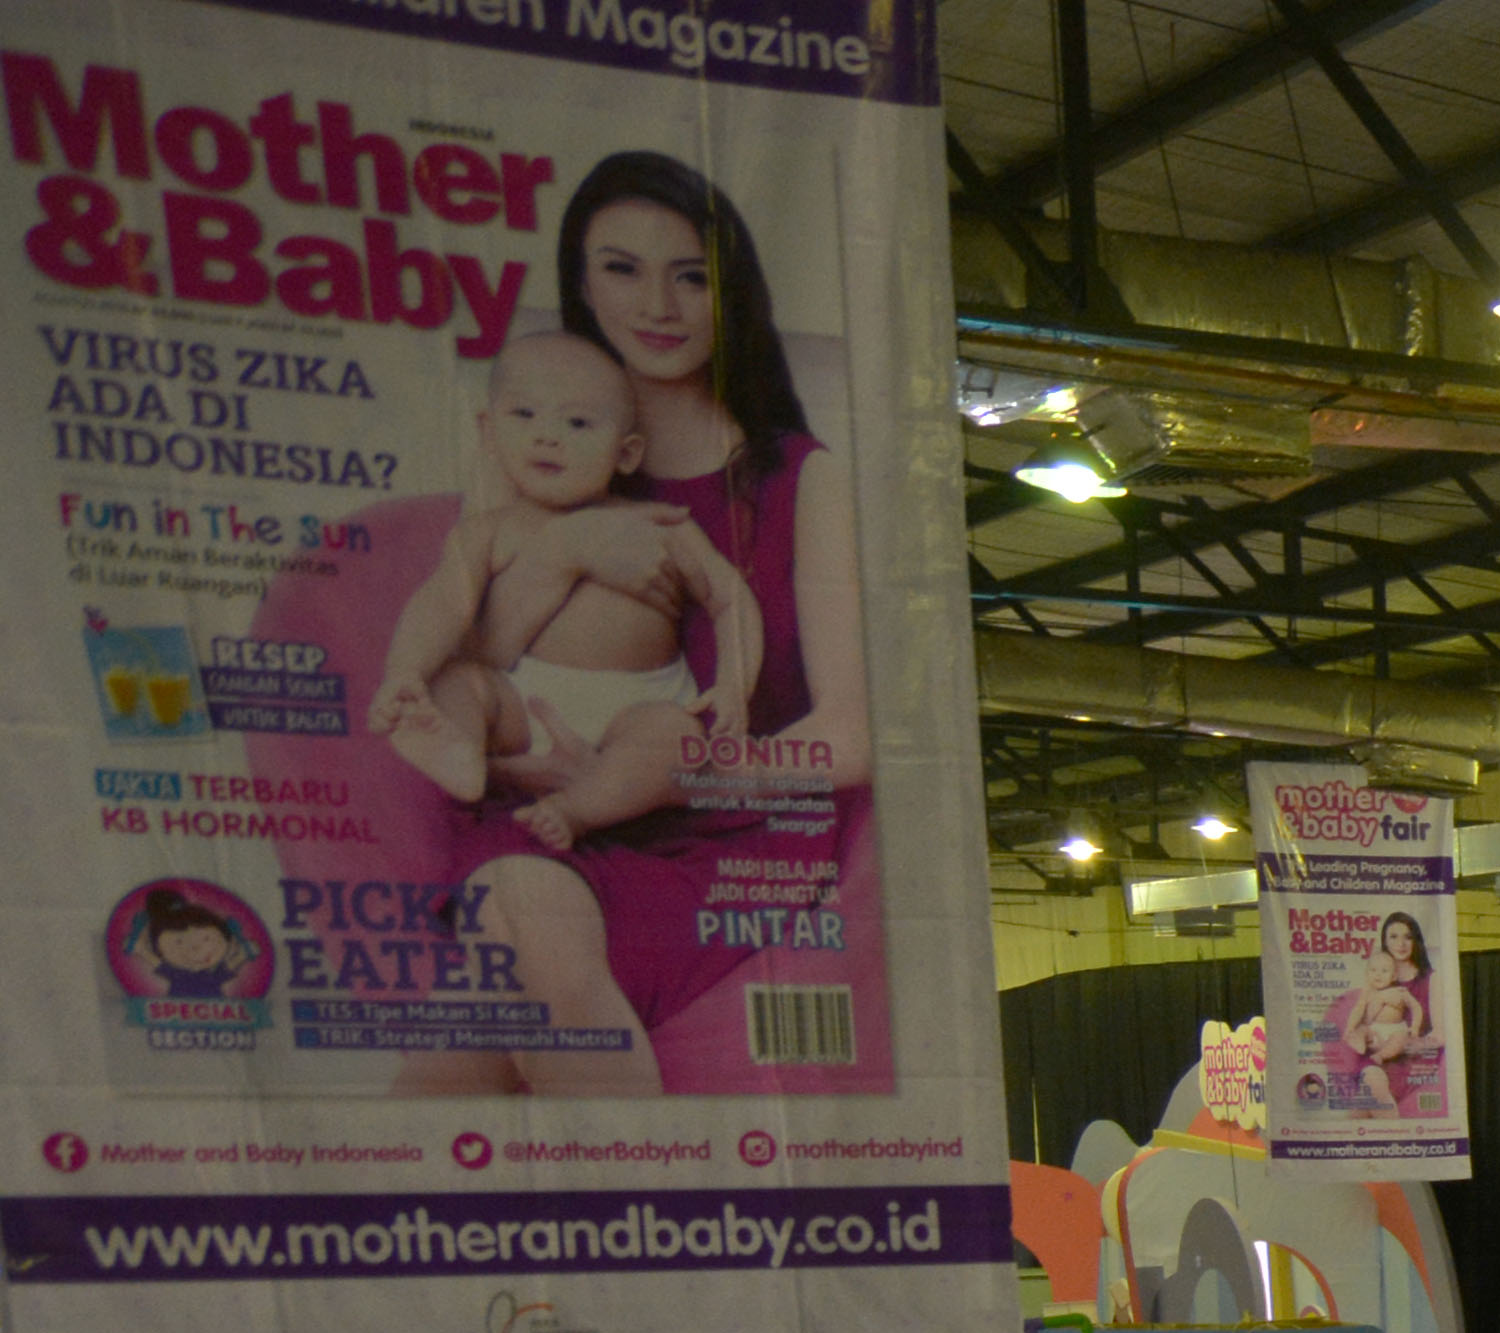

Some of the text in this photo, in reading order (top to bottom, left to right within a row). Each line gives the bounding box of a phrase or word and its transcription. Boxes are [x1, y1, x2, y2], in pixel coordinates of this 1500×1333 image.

[570, 0, 873, 76] Magazine
[0, 52, 555, 234] Mother
[24, 173, 528, 359] &Baby
[36, 324, 375, 399] VIRUS ZIKA
[47, 374, 251, 431] ADA DI
[52, 421, 399, 490] INDONESIA?
[58, 493, 371, 553] Fun in The Sun
[211, 637, 326, 673] RESEP
[680, 735, 834, 769] DONITA
[187, 774, 348, 806] TERBARU
[1275, 779, 1388, 814] mother
[101, 807, 380, 844] KB HORMONAL
[1280, 809, 1431, 848] &baby fair
[279, 879, 490, 934] PICKY
[1288, 907, 1380, 933] Mother
[697, 909, 845, 950] PINTAR
[1289, 930, 1377, 960] &Baby
[286, 938, 525, 993] EATER
[454, 1029, 555, 1047] Memenuhi
[1248, 1074, 1265, 1104] fai
[100, 1137, 425, 1172] Mother and Baby Indonesia
[503, 1135, 713, 1169] @MotherBabyInd
[785, 1133, 965, 1167] motherbabyind
[1287, 1141, 1456, 1159] www.motherandbaby.co.id
[86, 1201, 941, 1272] www.motherandbaby.co.id
